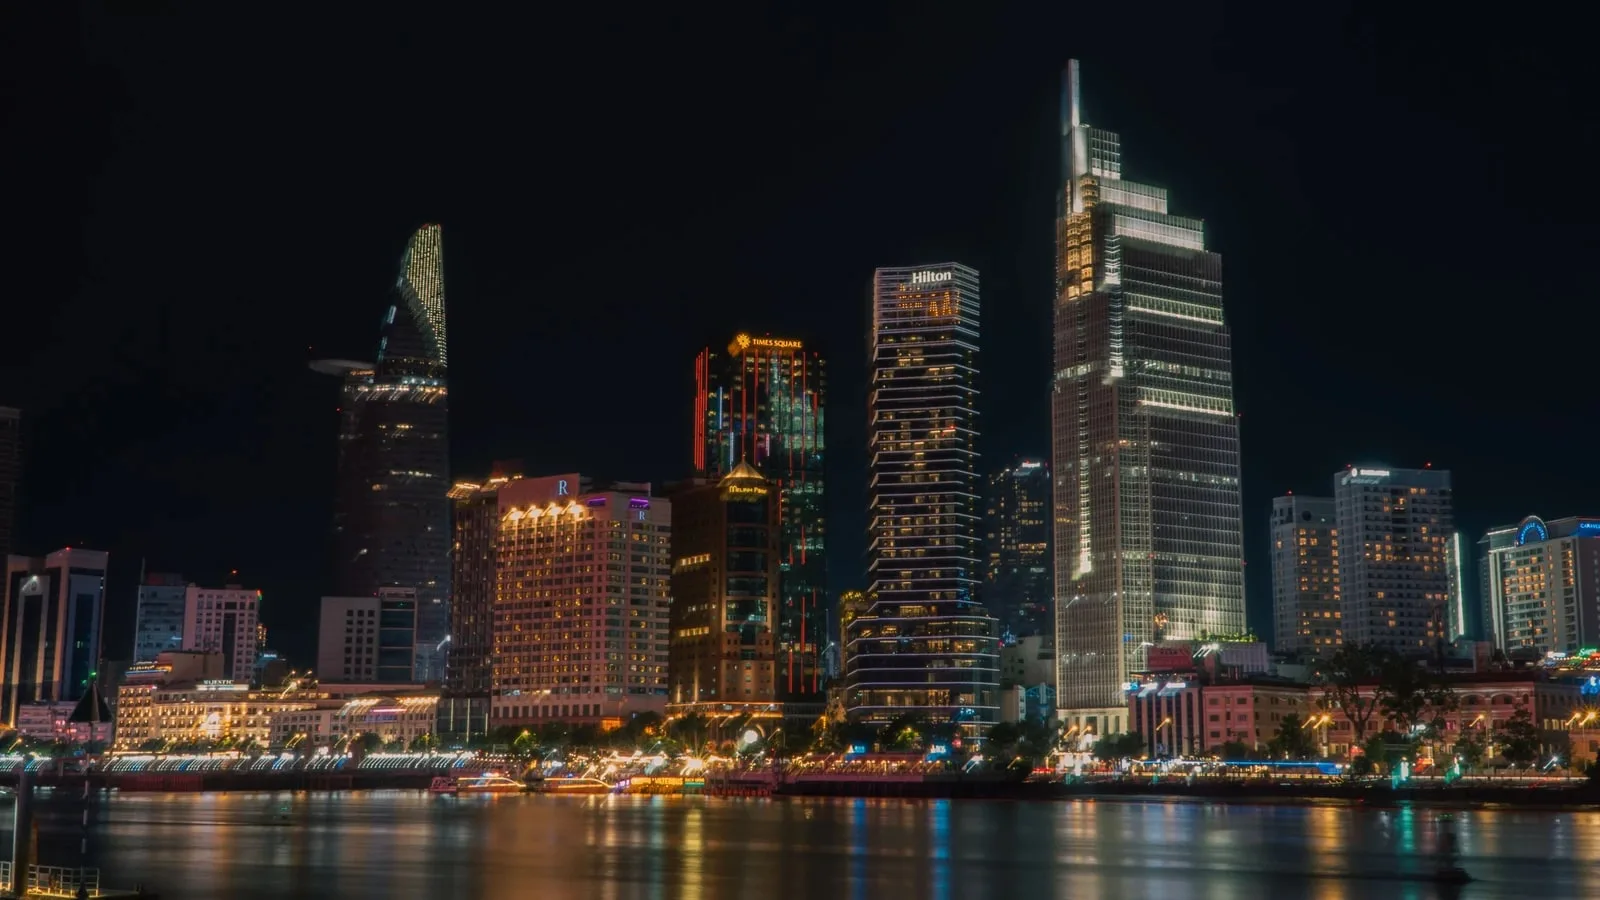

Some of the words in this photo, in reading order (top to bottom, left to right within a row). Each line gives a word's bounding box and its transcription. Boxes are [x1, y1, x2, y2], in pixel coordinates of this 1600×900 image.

[912, 270, 952, 284] Hilton
[752, 338, 773, 346] TIMES
[774, 340, 802, 348] SQUARE
[558, 480, 568, 496] R
[639, 511, 646, 520] R
